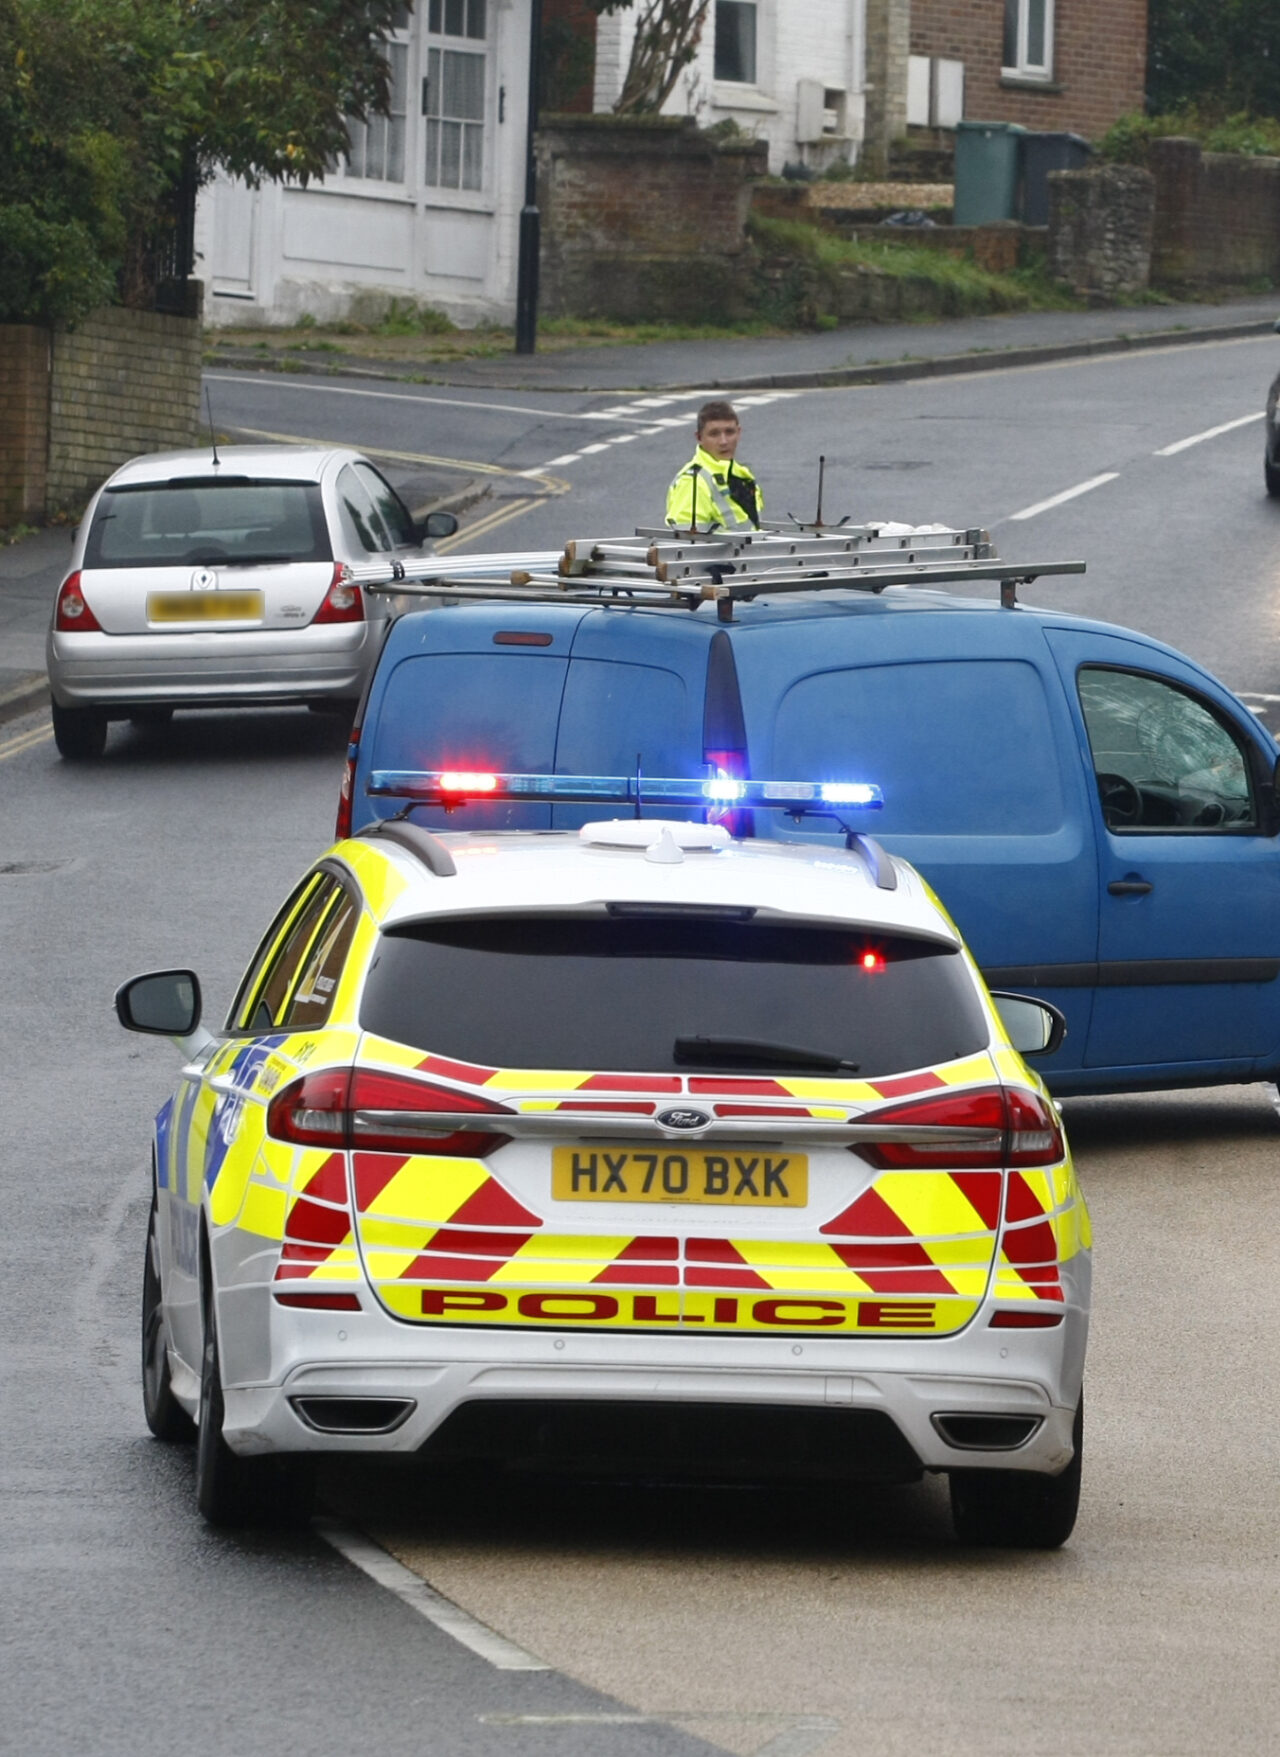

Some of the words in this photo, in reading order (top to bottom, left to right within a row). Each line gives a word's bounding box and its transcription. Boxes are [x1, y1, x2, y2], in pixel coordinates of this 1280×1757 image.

[668, 1111, 700, 1126] Ford
[571, 1153, 689, 1194] HX70
[704, 1156, 790, 1198] BXK
[421, 1289, 936, 1328] POLICE
